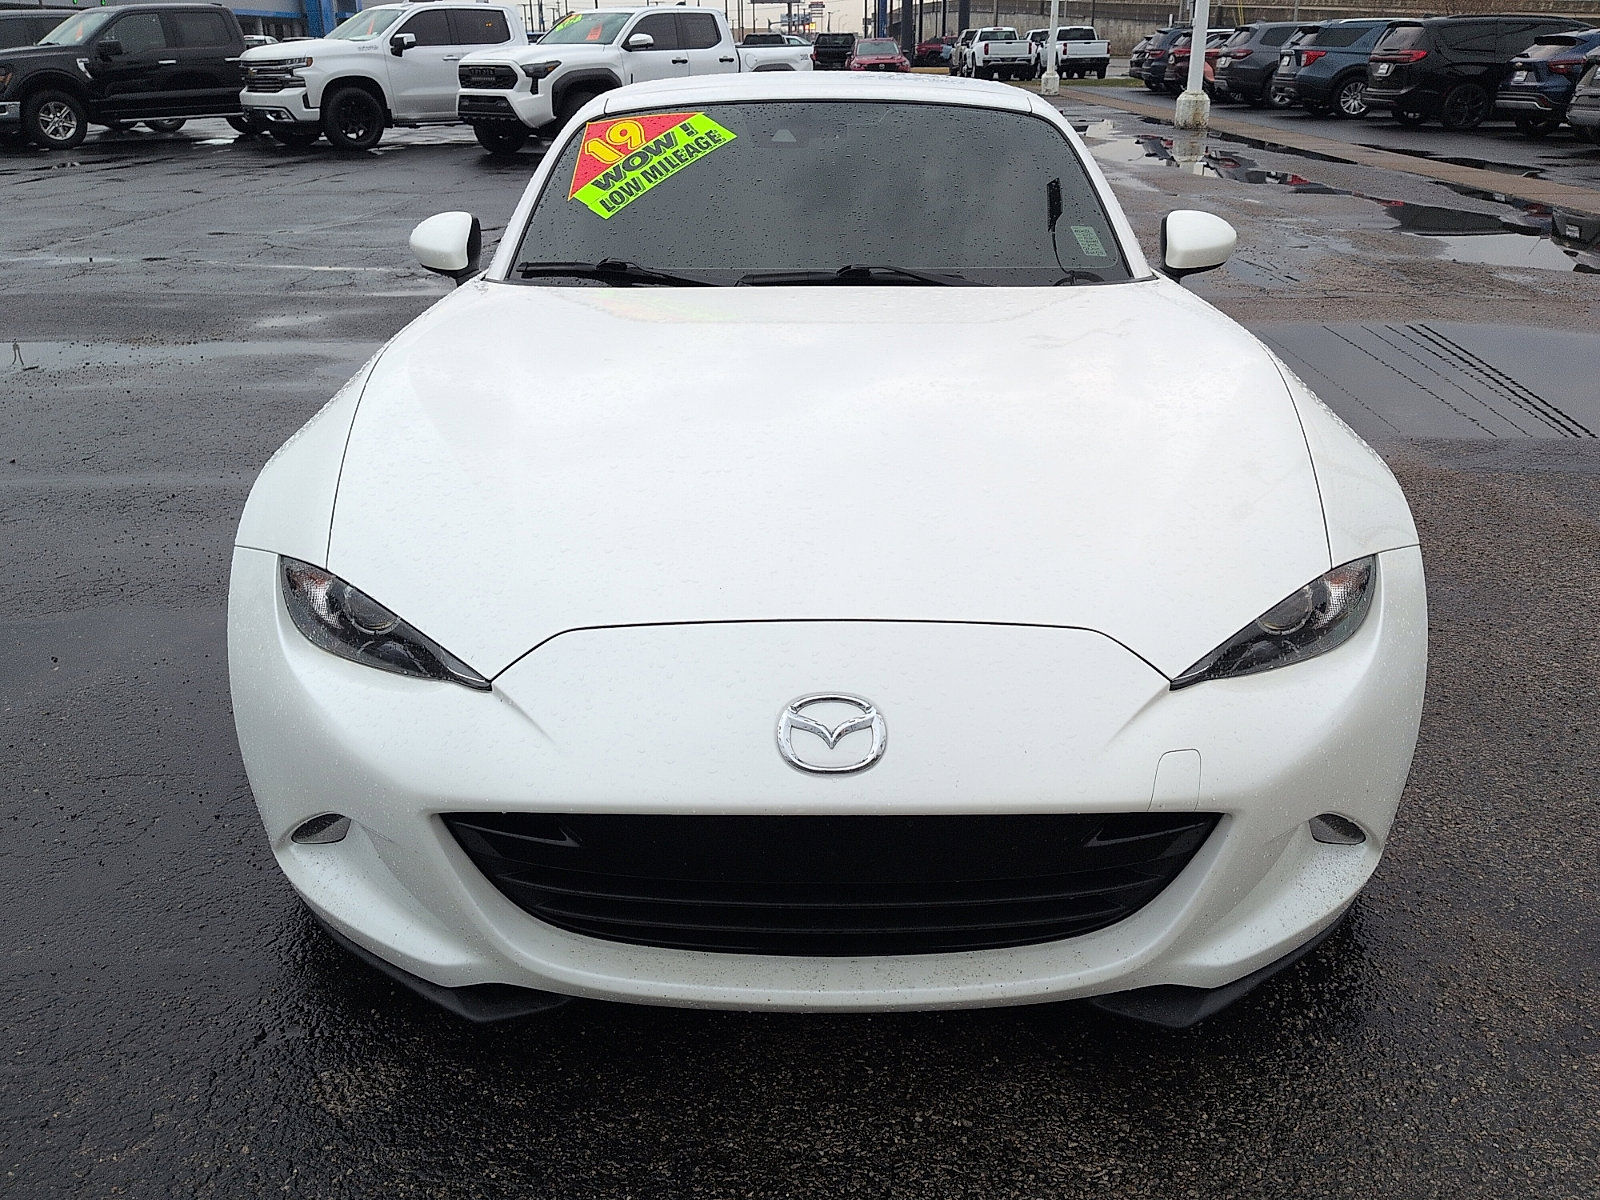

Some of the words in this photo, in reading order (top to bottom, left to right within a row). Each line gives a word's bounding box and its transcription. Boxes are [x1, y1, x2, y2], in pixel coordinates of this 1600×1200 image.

[585, 120, 646, 164] 19
[599, 176, 645, 212] LOW
[640, 129, 726, 184] MILEAGE
